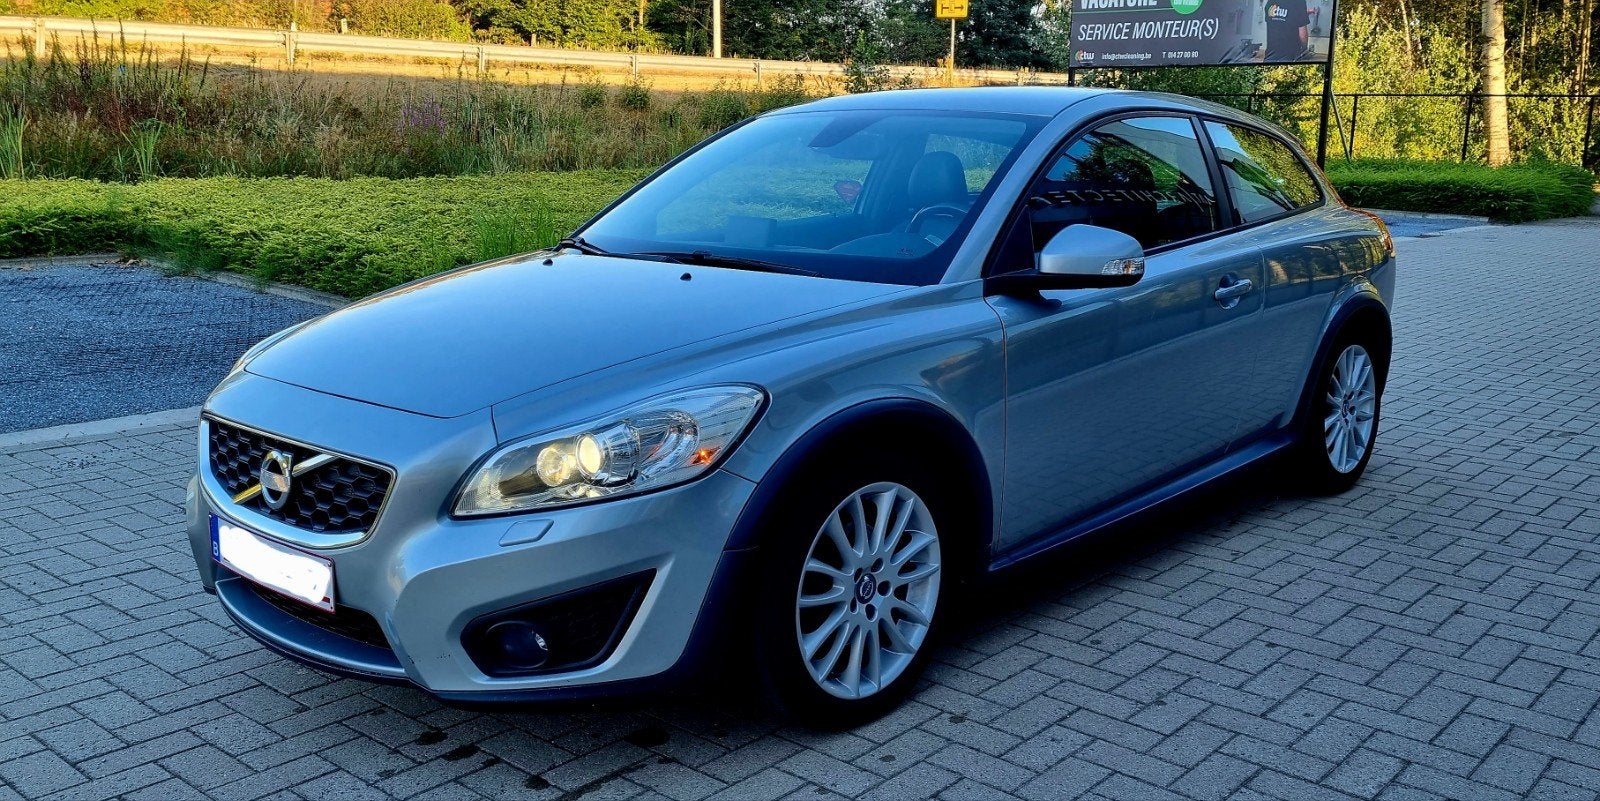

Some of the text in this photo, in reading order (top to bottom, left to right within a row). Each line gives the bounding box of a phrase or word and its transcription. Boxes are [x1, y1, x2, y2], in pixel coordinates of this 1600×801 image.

[1078, 18, 1219, 41] SERVICE MONTEUR(S)
[213, 541, 219, 556] B
